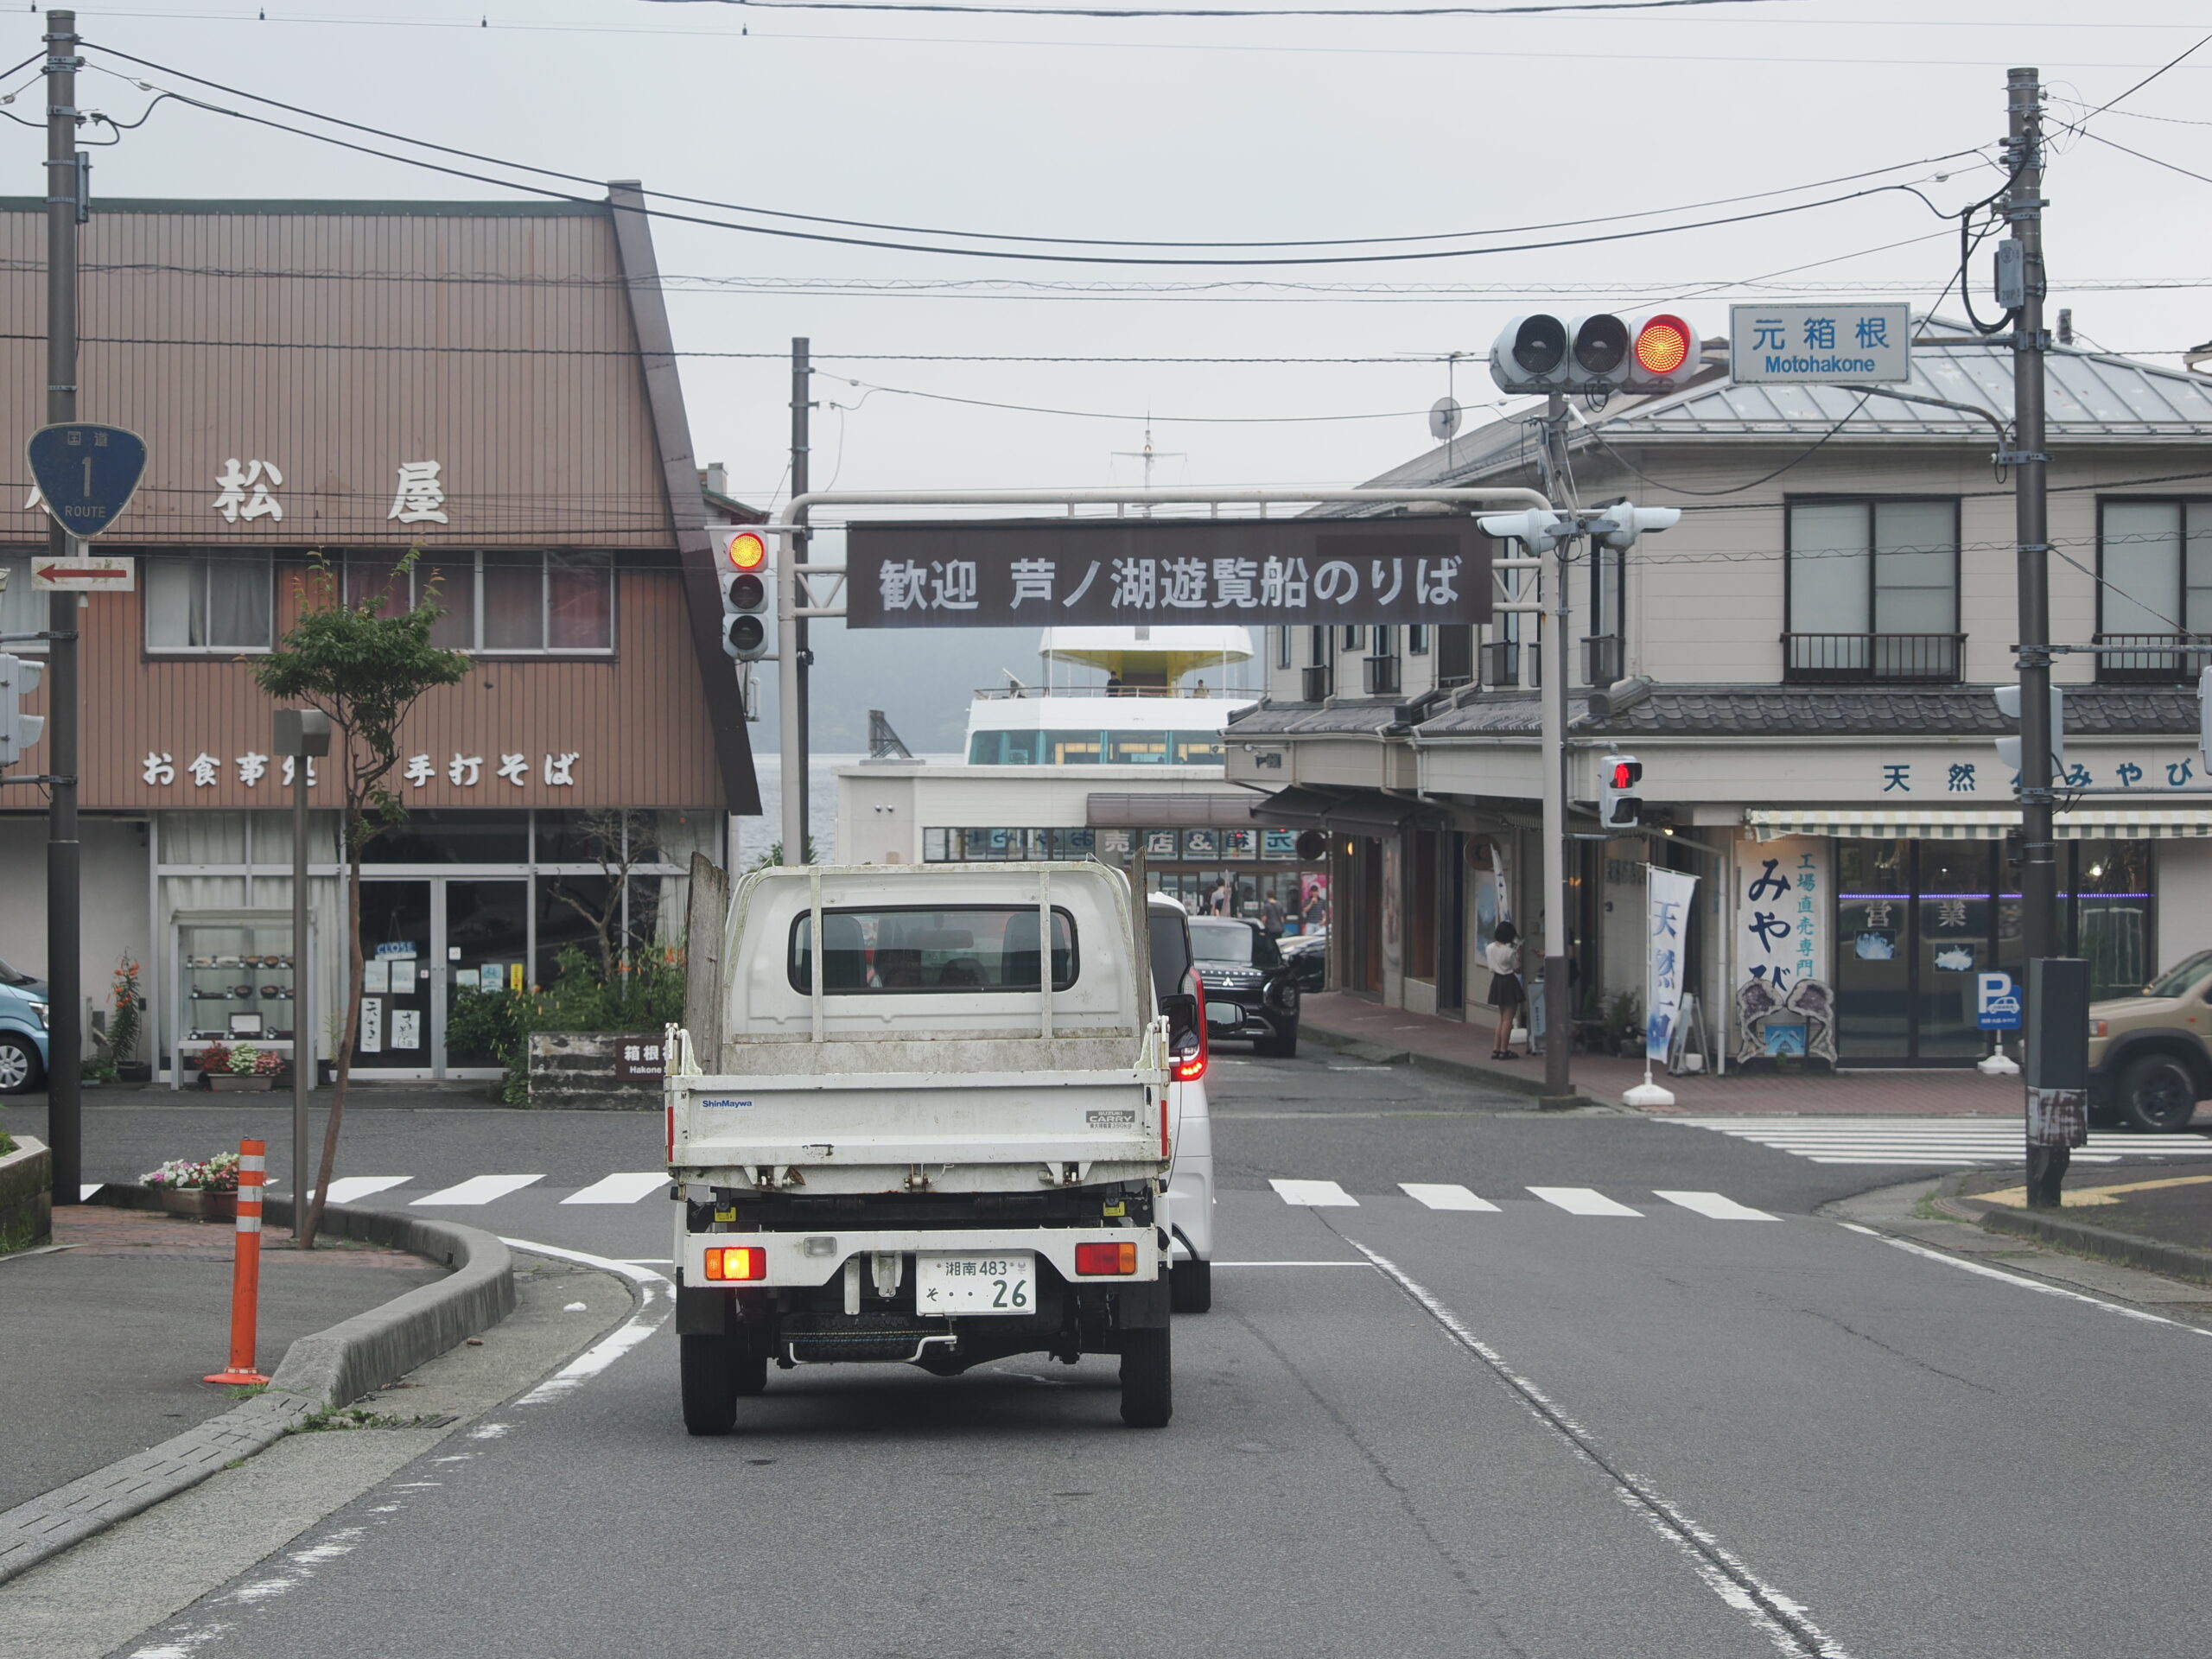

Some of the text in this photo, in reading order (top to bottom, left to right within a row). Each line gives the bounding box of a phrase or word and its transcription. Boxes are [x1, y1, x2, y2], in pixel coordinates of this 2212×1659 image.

[1752, 317, 1890, 350] 元箱根
[1765, 355, 1875, 373] Motohakone
[67, 431, 109, 447] 国道
[82, 457, 92, 498] 1
[65, 505, 106, 518] ROUTE
[880, 555, 1461, 610] 歓迎 芦ノ湖遊覧船のりば
[404, 753, 580, 787] 手打そば
[1883, 758, 2193, 792] 天然みやび
[1749, 858, 1791, 992] みやび
[1796, 854, 1816, 977] 工場直売専門
[377, 941, 416, 954] CLOSE
[1979, 973, 2012, 1014] P
[630, 1065, 662, 1074] Hakone
